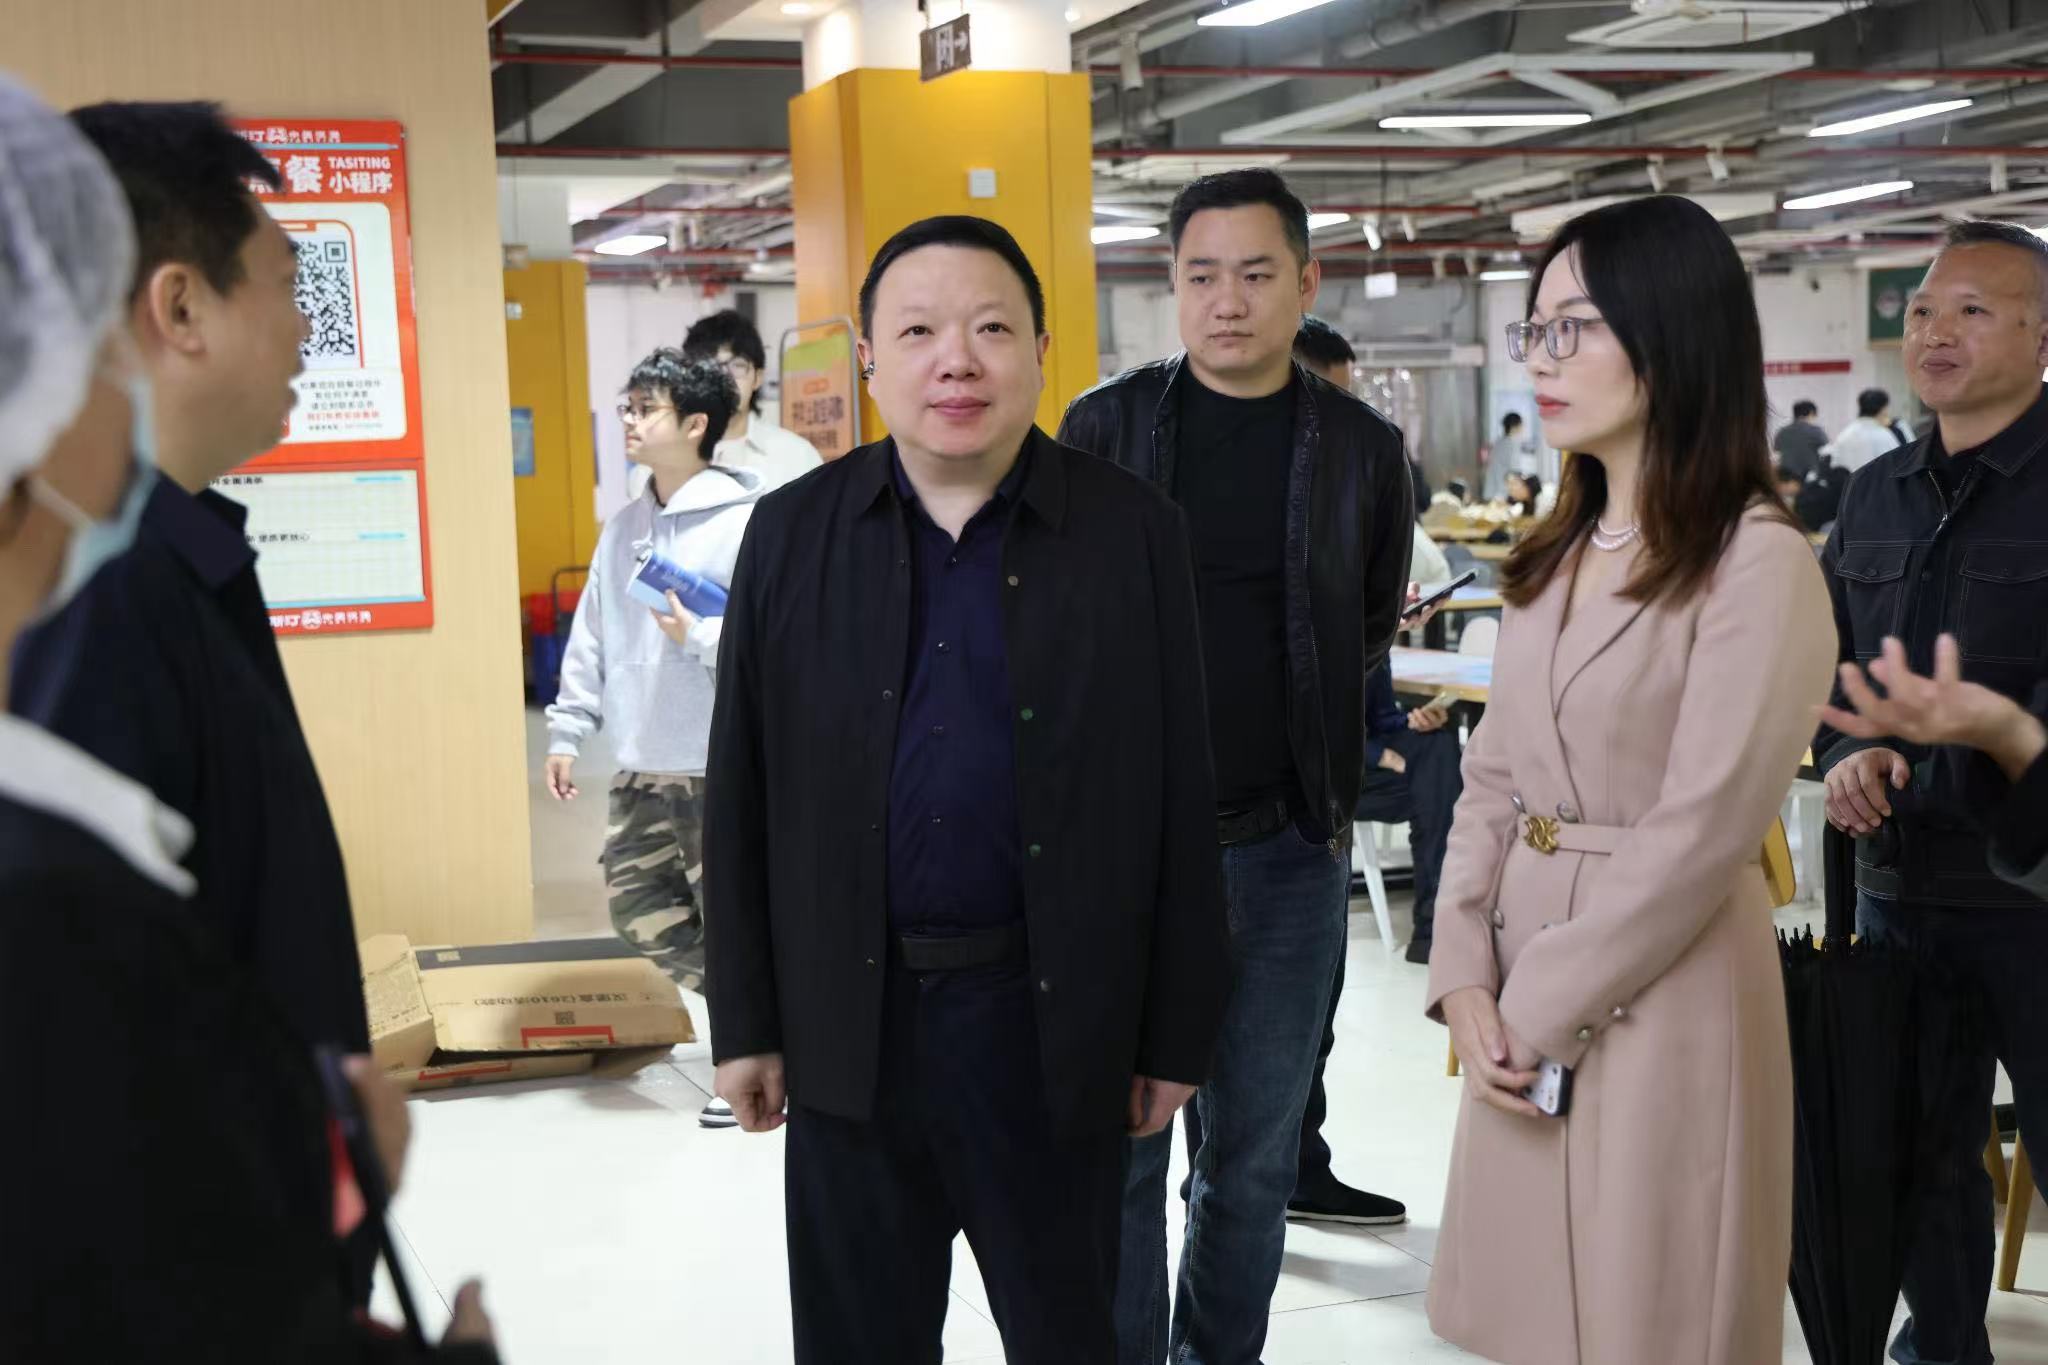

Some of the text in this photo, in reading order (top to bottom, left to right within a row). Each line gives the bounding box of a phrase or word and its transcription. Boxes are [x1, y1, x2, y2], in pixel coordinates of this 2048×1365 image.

[328, 156, 391, 170] TASITING
[329, 172, 393, 194] 小程序
